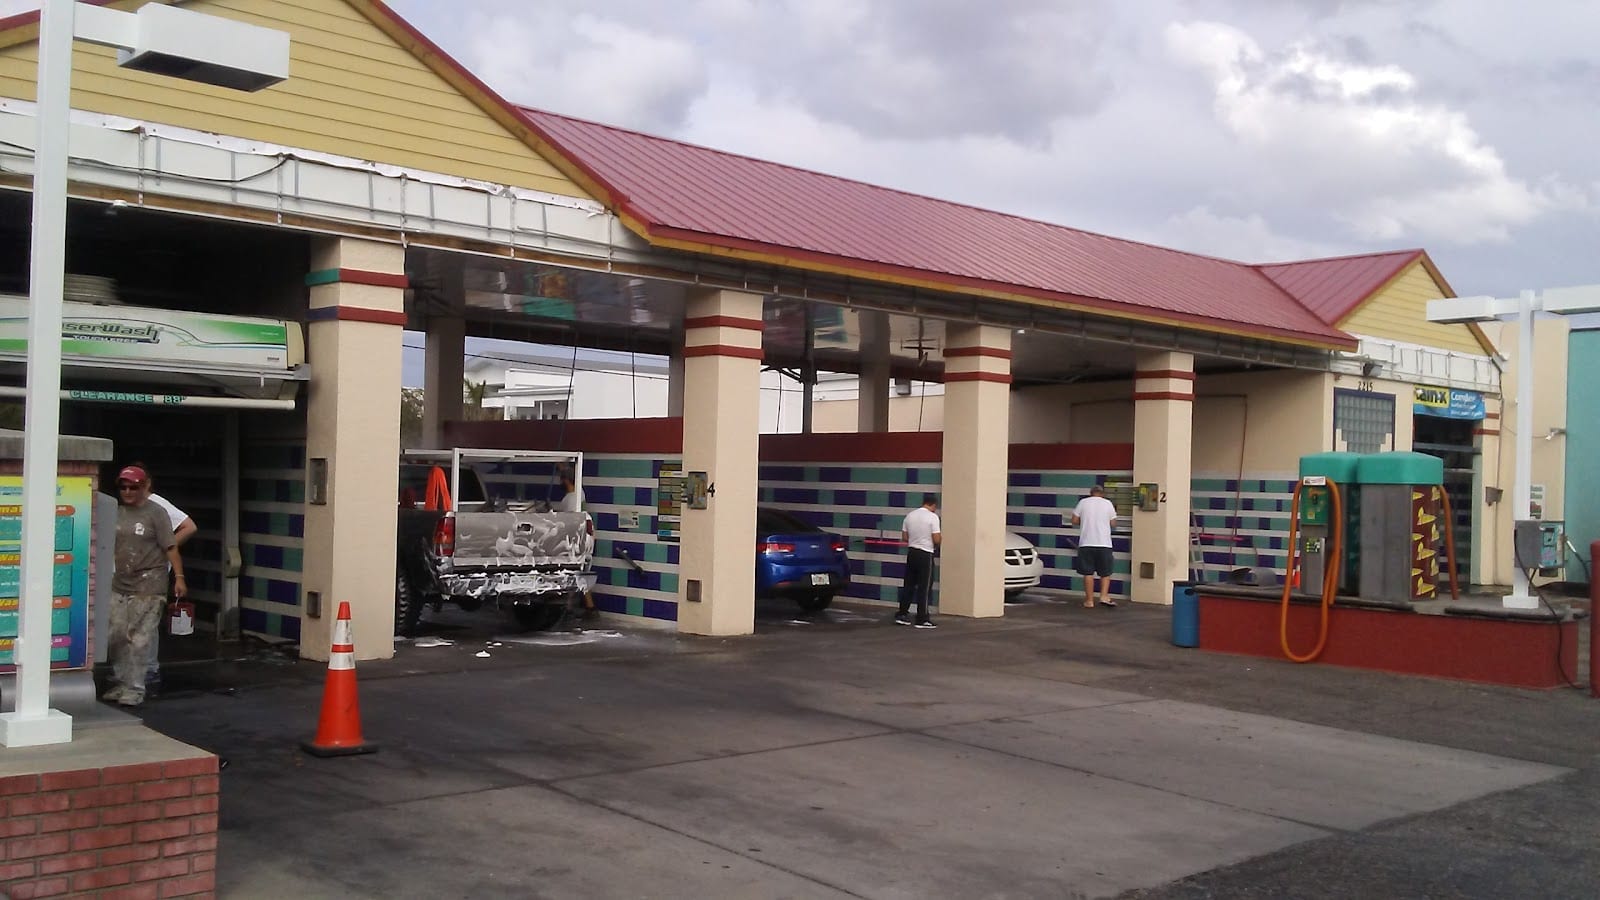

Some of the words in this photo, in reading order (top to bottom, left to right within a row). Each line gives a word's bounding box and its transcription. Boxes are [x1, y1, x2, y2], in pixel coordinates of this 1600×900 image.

[62, 322, 160, 341] serWash
[1358, 381, 1374, 391] 2215
[70, 389, 154, 403] CLEARANCE
[707, 482, 715, 497] 4
[1160, 492, 1166, 503] 2
